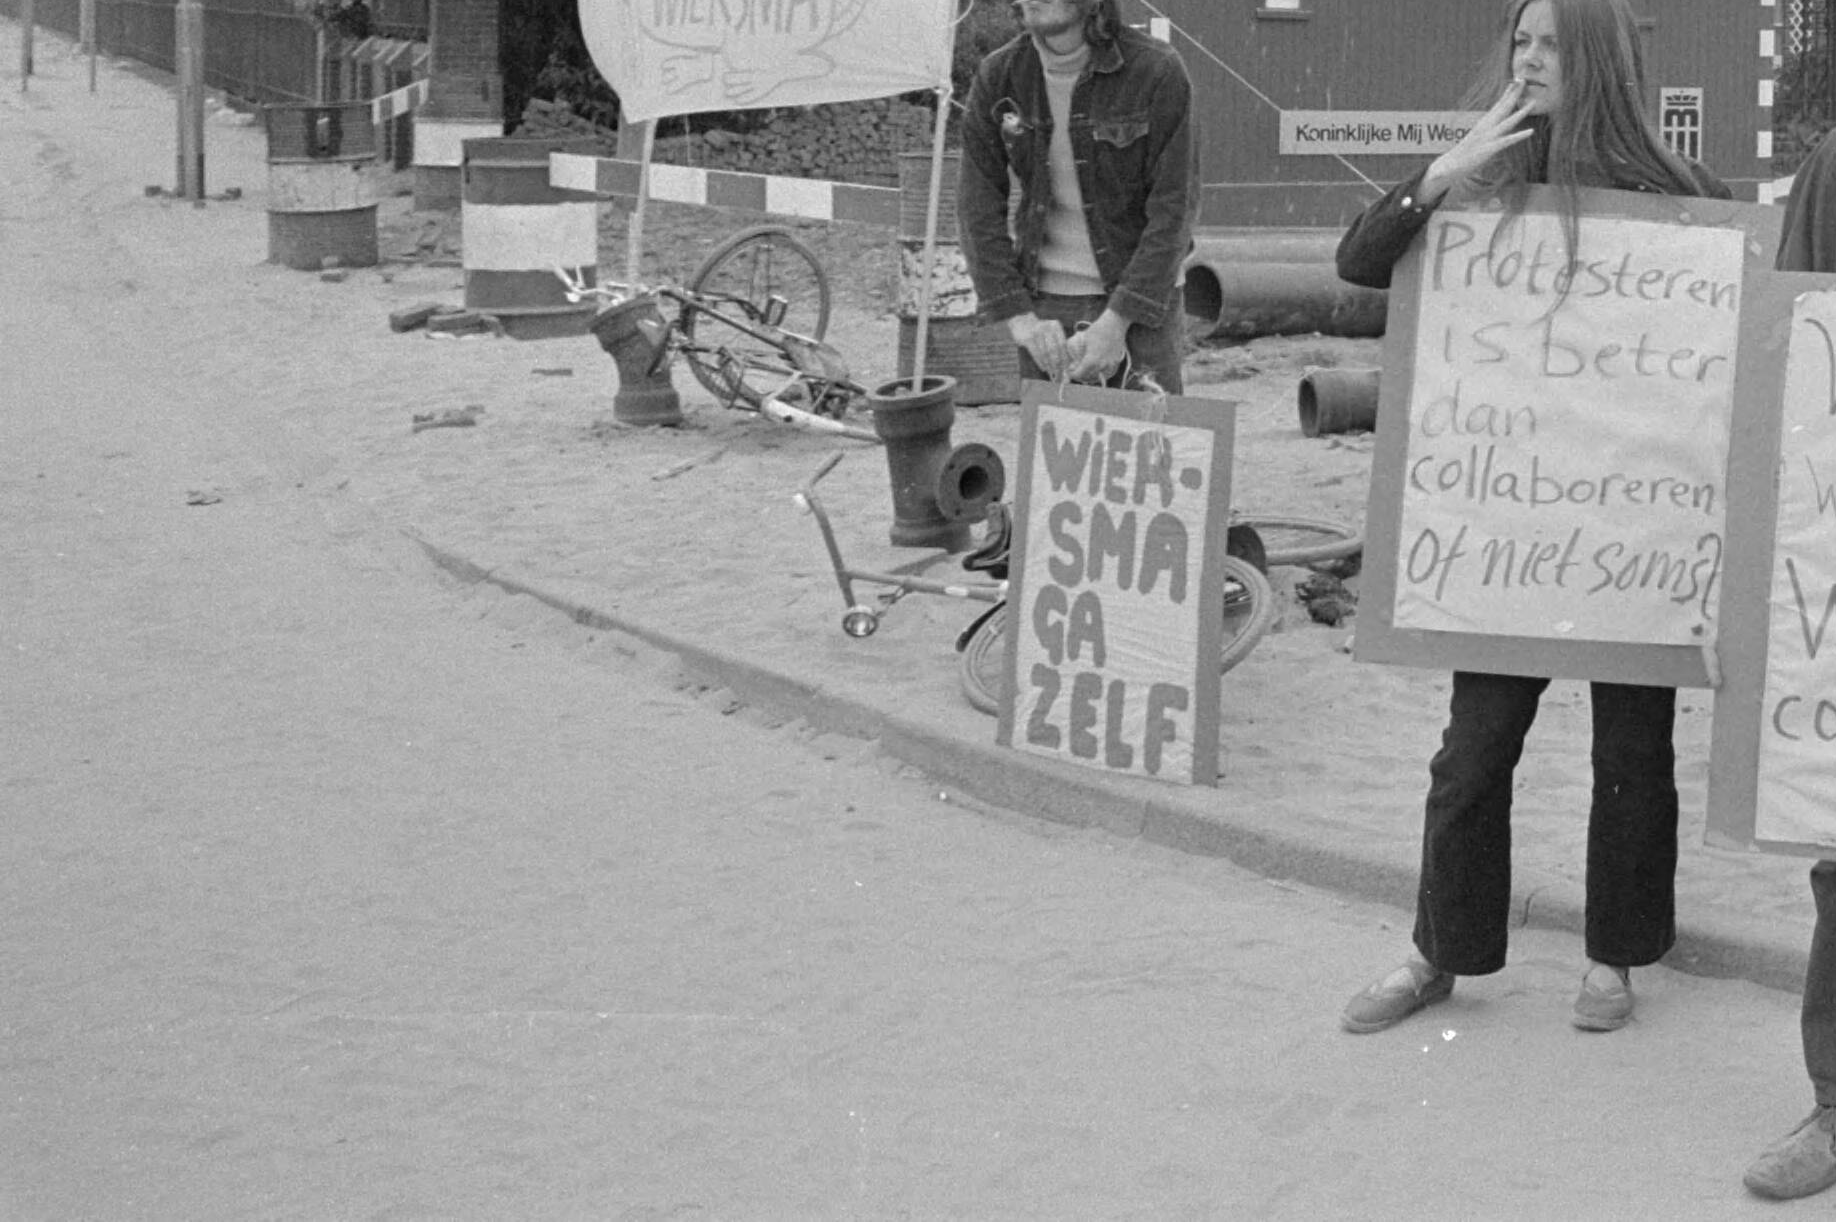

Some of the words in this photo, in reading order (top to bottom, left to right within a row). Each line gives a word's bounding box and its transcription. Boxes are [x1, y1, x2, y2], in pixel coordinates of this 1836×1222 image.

[1295, 122, 1392, 146] Koninklijke
[1396, 123, 1423, 145] Mij
[1427, 123, 1472, 145] Weg
[1432, 219, 1738, 311] Protesteren
[1542, 314, 1727, 383] beter
[1420, 379, 1538, 439] dan
[1410, 445, 1716, 516] collaboreren
[1047, 500, 1190, 605] SMA
[1482, 527, 1583, 589] niet
[1032, 584, 1106, 669] GA
[1026, 662, 1190, 776] ZELF
